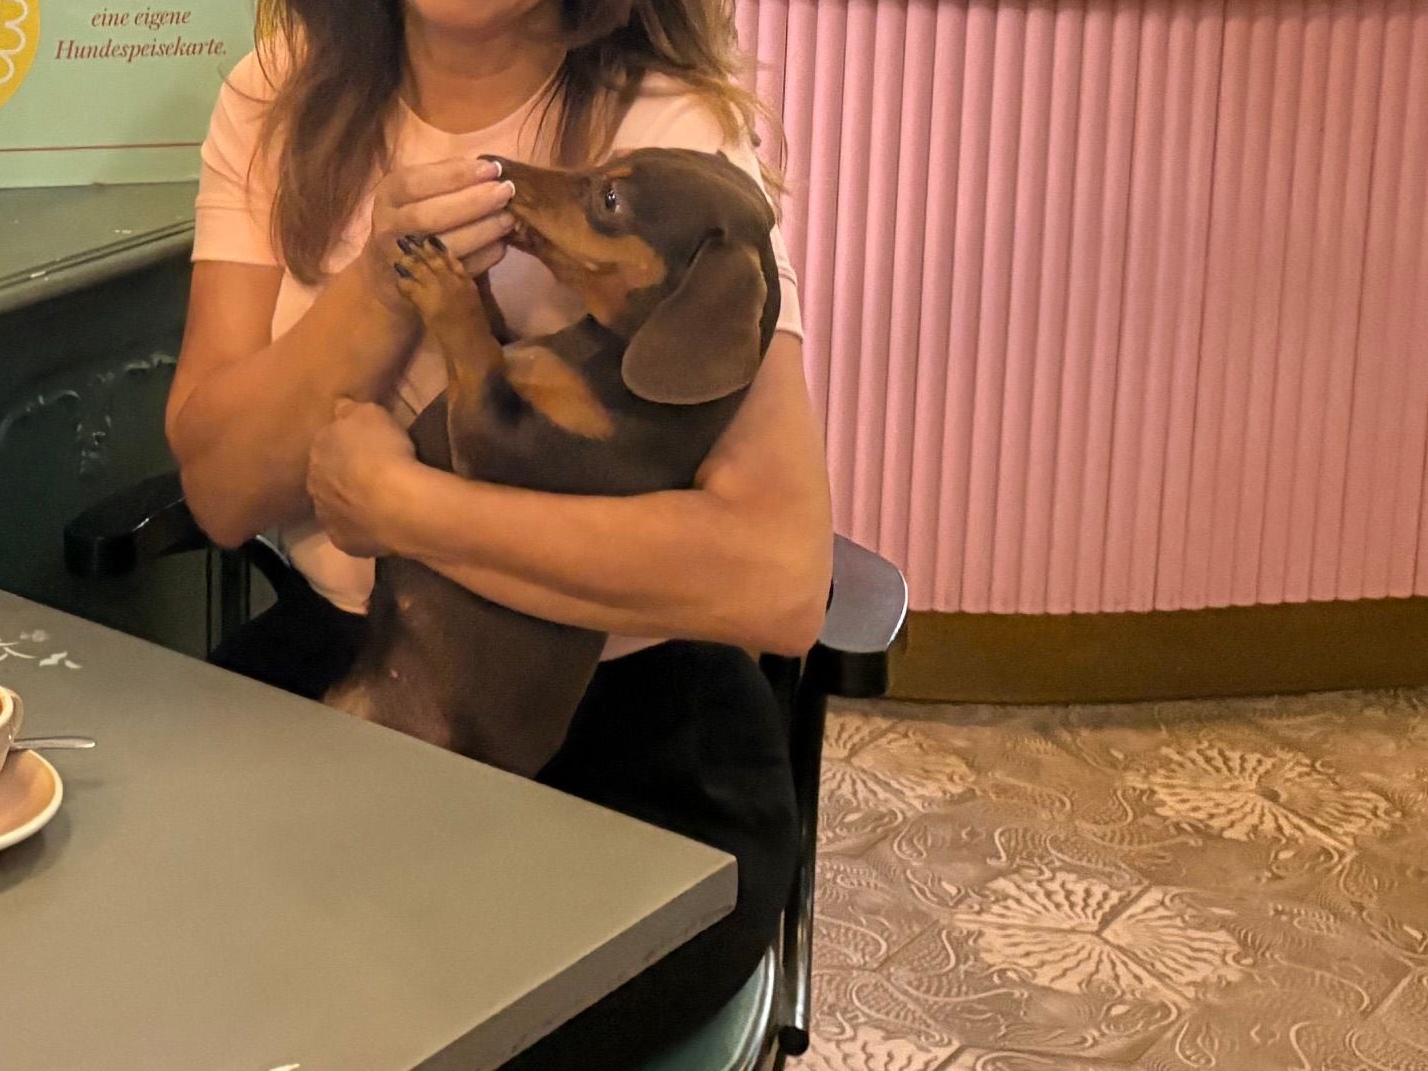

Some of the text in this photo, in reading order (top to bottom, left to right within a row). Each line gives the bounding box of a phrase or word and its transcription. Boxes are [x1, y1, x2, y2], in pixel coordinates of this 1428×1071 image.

[91, 7, 191, 30] eine eigene
[54, 36, 227, 63] Hundespeisekarte.
